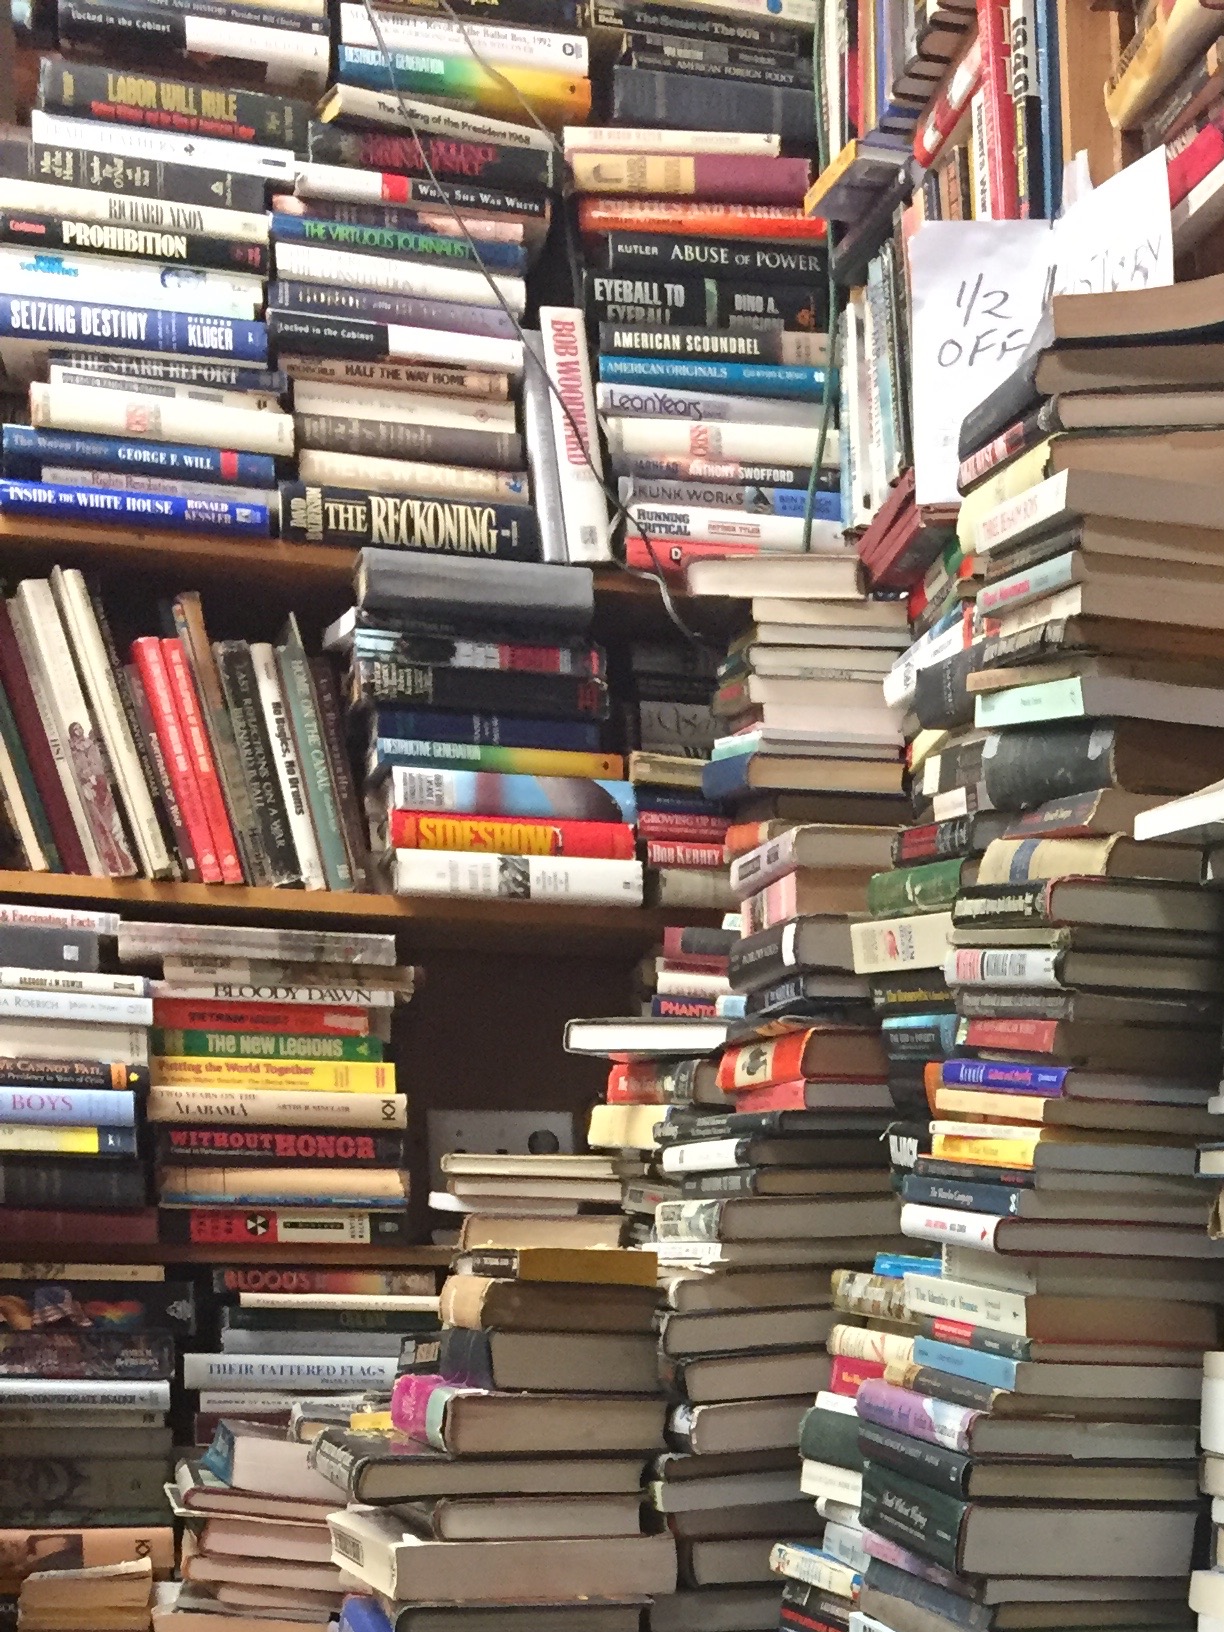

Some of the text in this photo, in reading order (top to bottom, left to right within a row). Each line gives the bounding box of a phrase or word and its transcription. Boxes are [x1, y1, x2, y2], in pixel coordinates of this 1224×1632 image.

[107, 73, 157, 108] LABOR
[160, 81, 197, 115] WILL
[201, 89, 238, 122] RULE
[377, 101, 396, 114] The
[108, 198, 164, 226] RICHARD
[62, 220, 187, 259] PROHIBITION
[326, 225, 394, 248] VIRTUOUS
[670, 245, 730, 266] ABUSE
[734, 254, 751, 267] OF
[755, 251, 822, 272] POWER
[594, 278, 685, 308] EYEBALL TO
[10, 299, 149, 342] SEIZING DESTINY
[187, 323, 233, 351] KLUGER
[551, 319, 579, 355] BOB
[613, 331, 760, 355] AMERICAN SCOUNDREL
[937, 328, 1031, 368] OFF
[345, 364, 375, 378] HALF
[380, 367, 401, 381] THE
[406, 370, 429, 383] WAY
[433, 373, 464, 386] HOME
[118, 447, 167, 466] GEORGE
[183, 455, 214, 471] WILL
[738, 467, 794, 483] SWOFFORD
[8, 486, 56, 507] INSIDE
[76, 492, 122, 513] WHITE
[126, 496, 173, 516] HOUSE
[632, 485, 745, 507] SKUNK WORKS
[324, 502, 368, 533] THE
[368, 495, 498, 554] RECKONING
[272, 701, 283, 715] No
[284, 760, 297, 776] No
[288, 777, 305, 816] Drums
[418, 817, 556, 855] SIDESHOW
[652, 845, 674, 863] BOB
[71, 914, 96, 928] Facts
[214, 982, 373, 1003] BLOODY DAWN
[205, 1062, 221, 1074] the
[225, 1062, 260, 1075] World
[264, 1063, 315, 1078] Together
[11, 1094, 73, 1112] BOYS
[175, 1101, 248, 1117] ALABAMA
[169, 1130, 376, 1160] WITHOUT HONOR
[208, 1362, 386, 1377] THEIR TATTERED FLAGS
